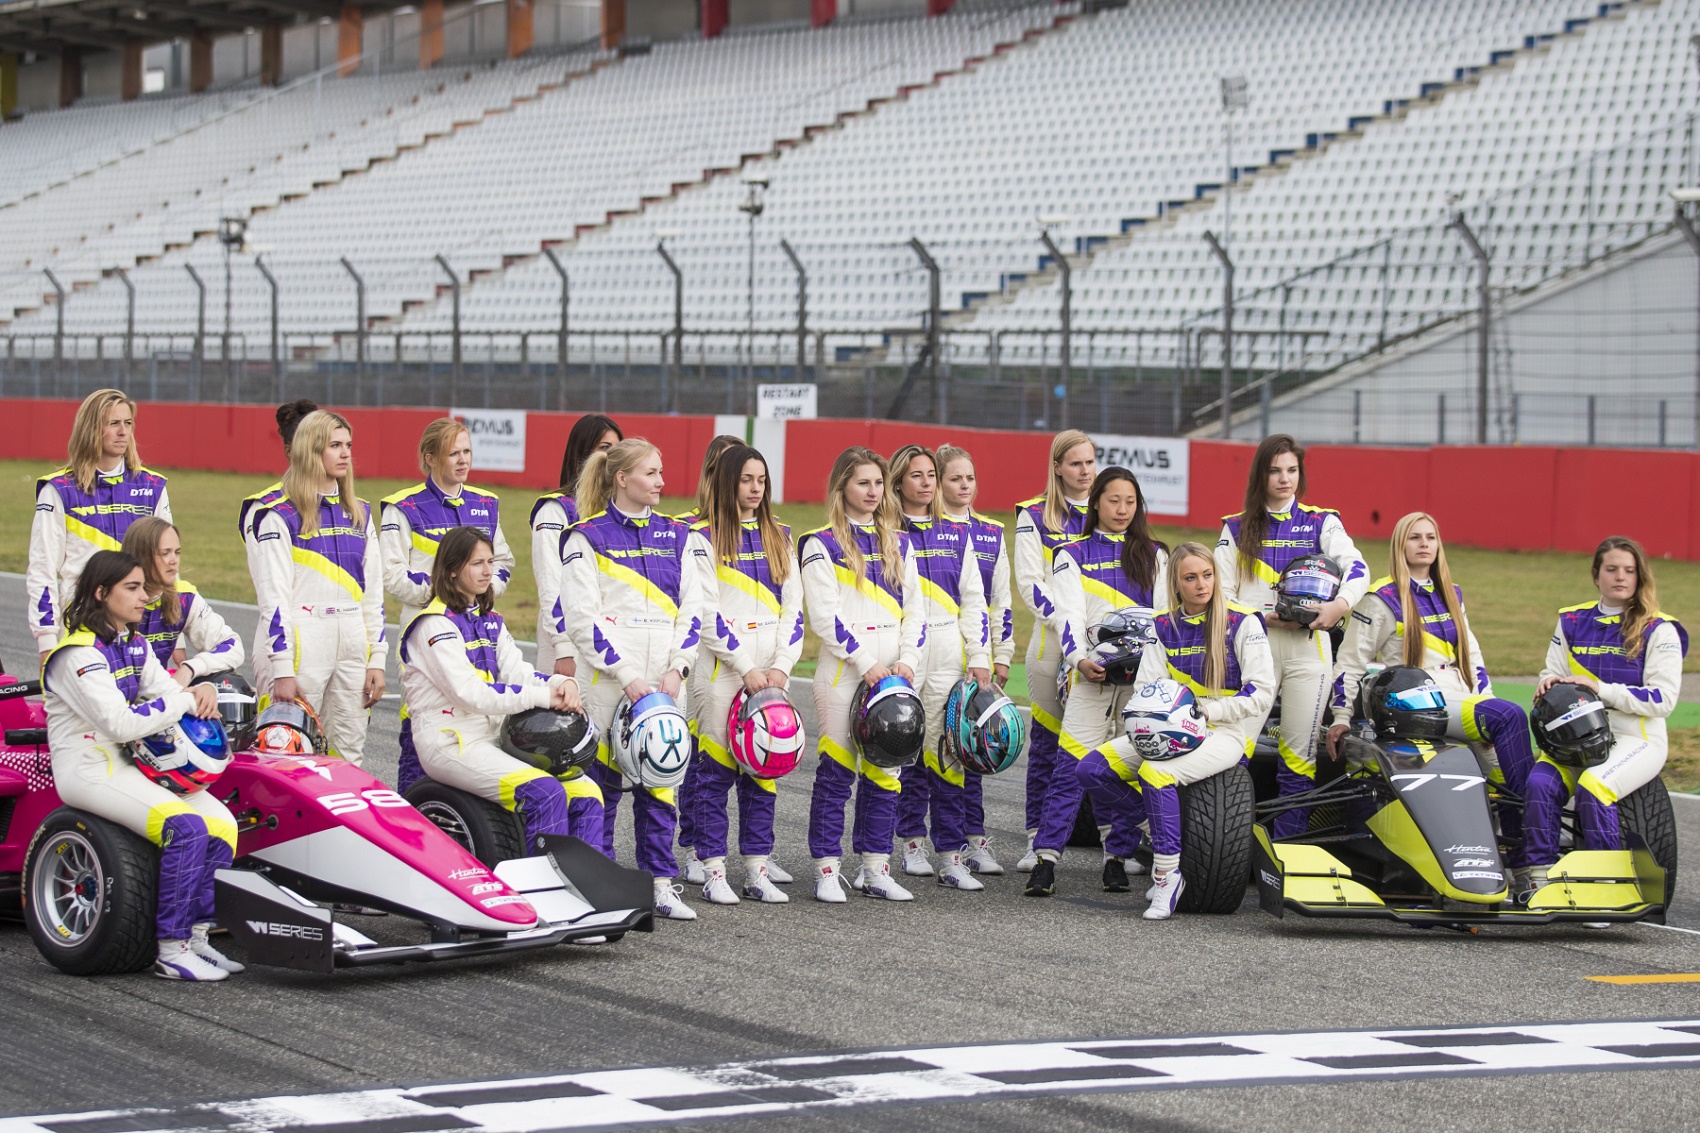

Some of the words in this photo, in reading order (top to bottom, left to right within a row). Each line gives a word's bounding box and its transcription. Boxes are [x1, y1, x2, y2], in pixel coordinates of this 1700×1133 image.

[463, 417, 514, 435] REMUS
[1095, 446, 1170, 469] REMUS
[129, 488, 153, 497] DTM
[471, 508, 489, 516] DTM
[1291, 524, 1314, 532] DTM
[654, 530, 676, 538] DTM
[937, 533, 959, 541] DTM
[976, 534, 997, 543] DTM
[1261, 539, 1314, 548] SERIES
[216, 680, 233, 690] tilo
[1601, 742, 1648, 780] #RETHINKRACING
[1390, 774, 1487, 792] 77
[316, 789, 411, 816] 58
[246, 920, 268, 934] W
[269, 923, 323, 942] SERIES
